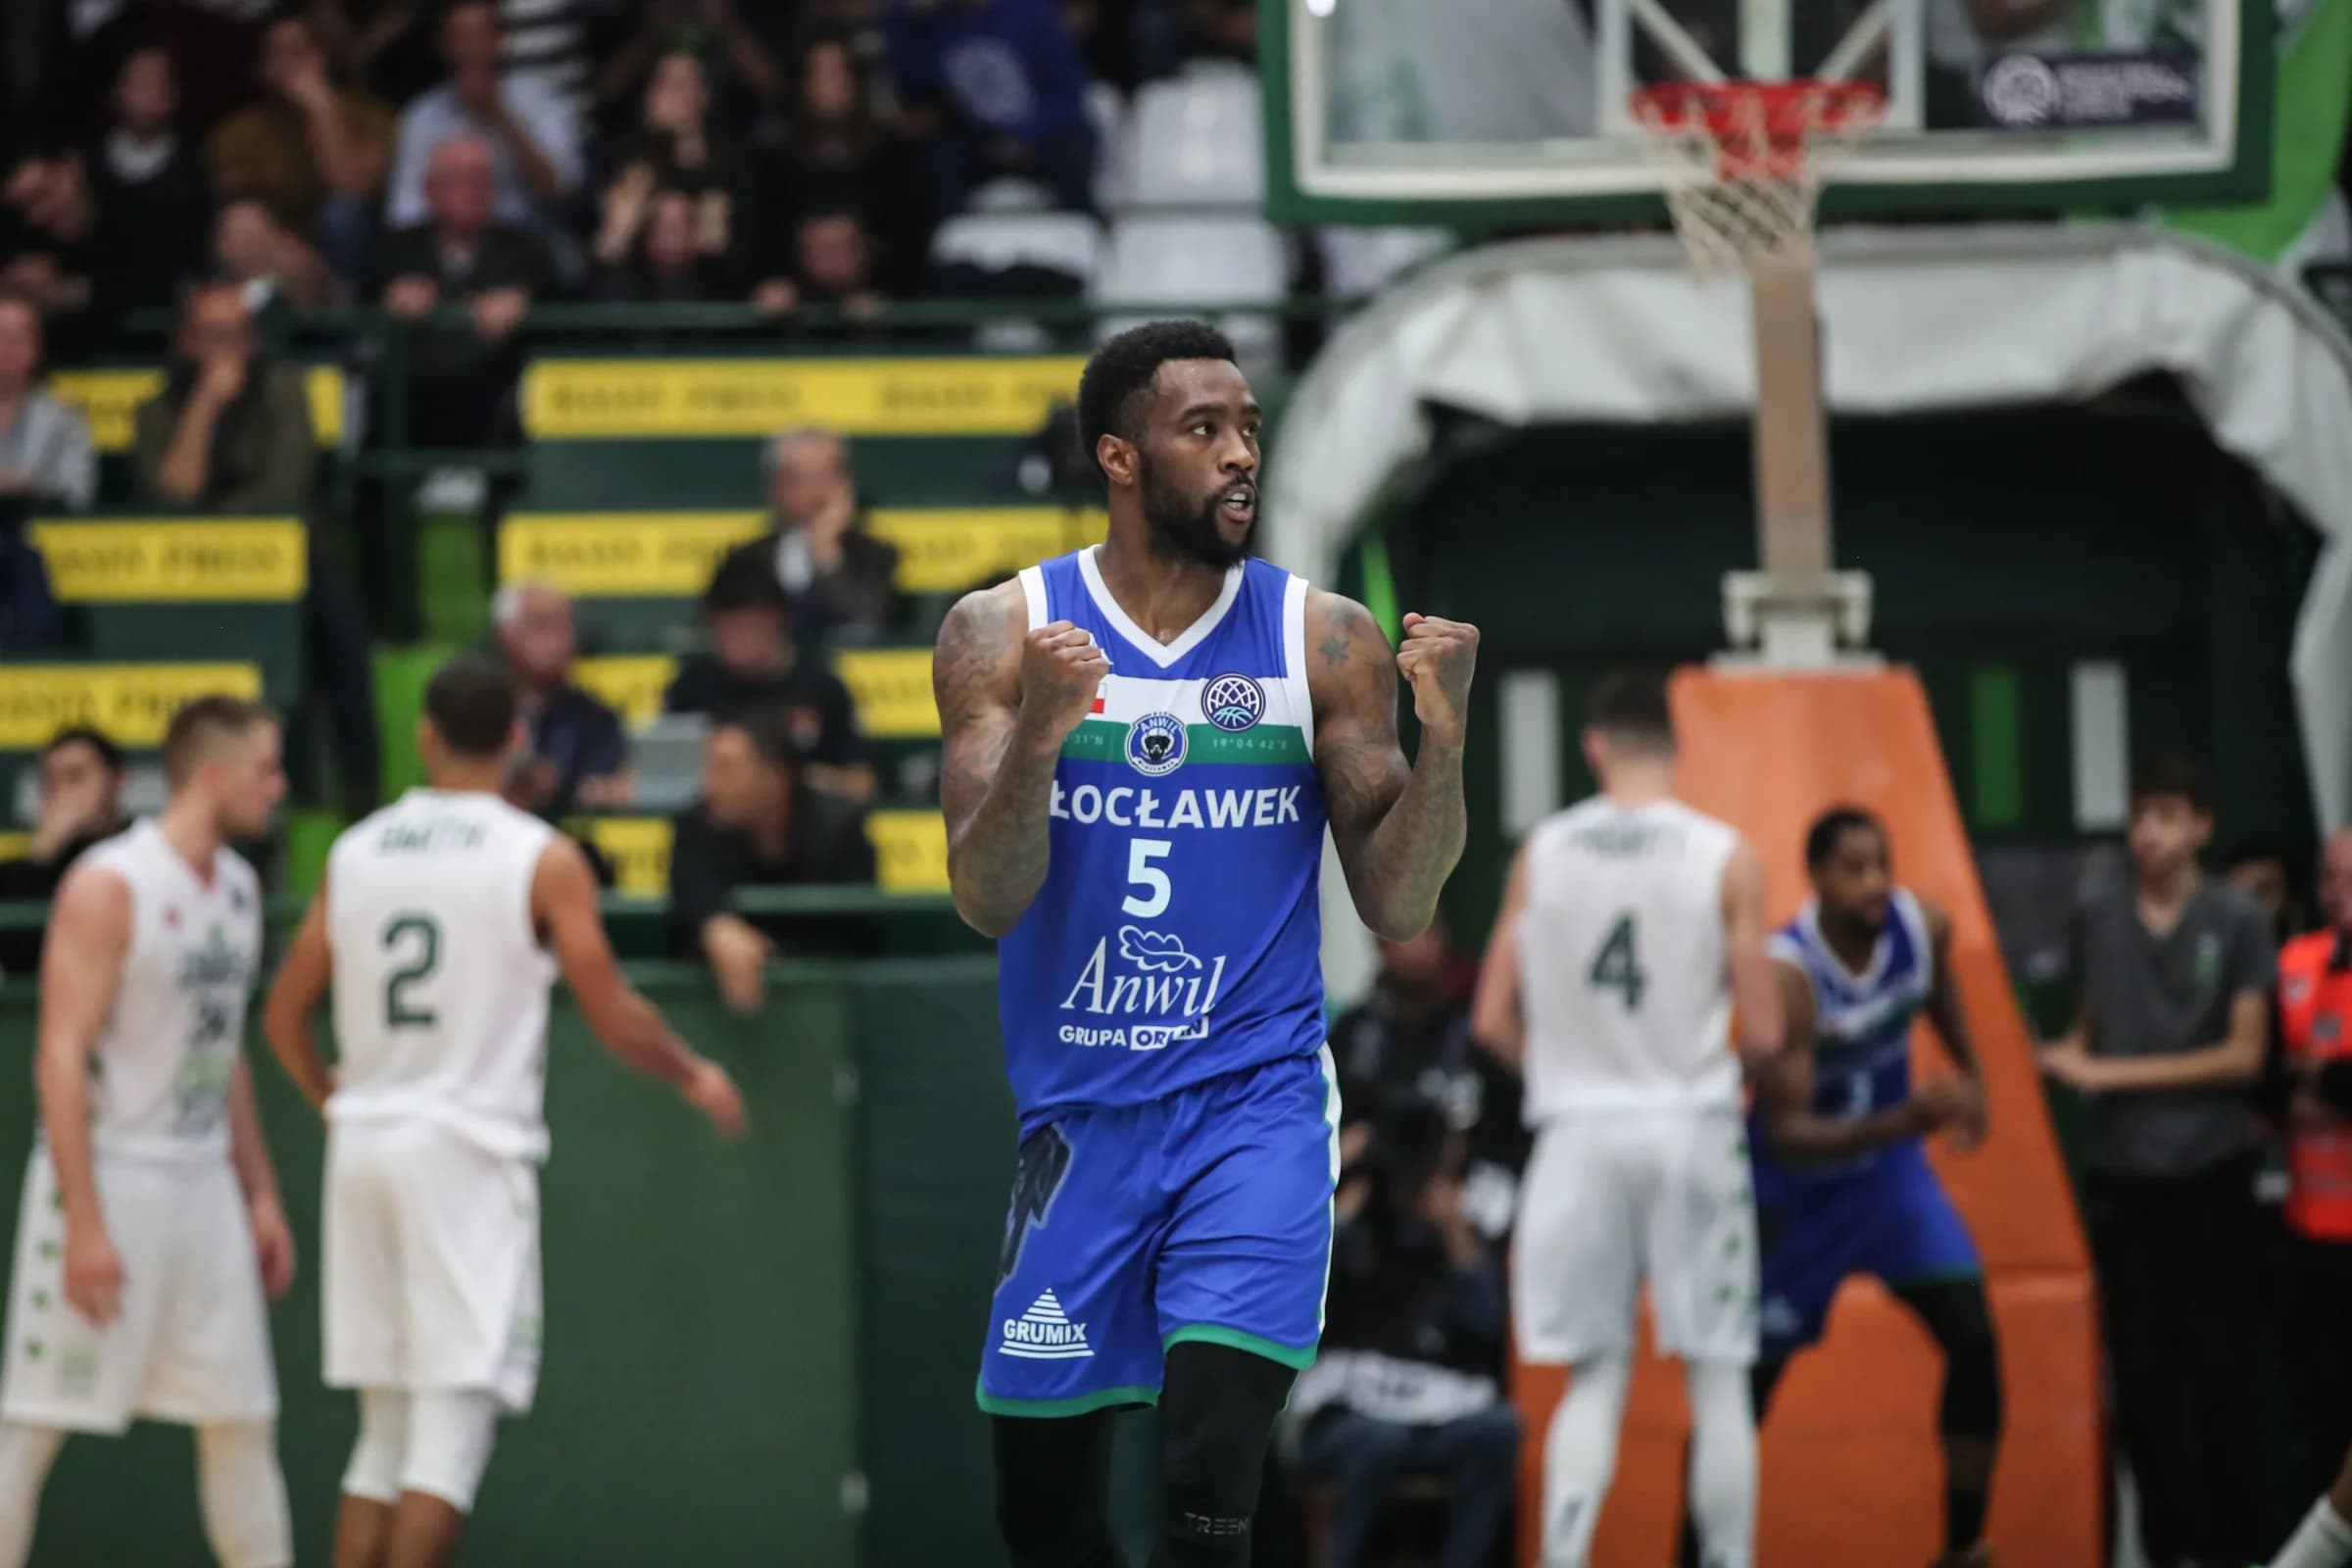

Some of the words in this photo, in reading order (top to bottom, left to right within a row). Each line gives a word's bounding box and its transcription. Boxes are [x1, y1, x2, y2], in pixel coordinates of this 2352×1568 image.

[1140, 716, 1179, 734] ANWIL
[1121, 838, 1173, 919] 5
[381, 911, 446, 1029] 2
[1059, 935, 1227, 1017] Anwil
[1590, 911, 1648, 1011] 4
[1058, 1024, 1127, 1047] GRUPA
[1003, 1318, 1087, 1344] GRUMIX
